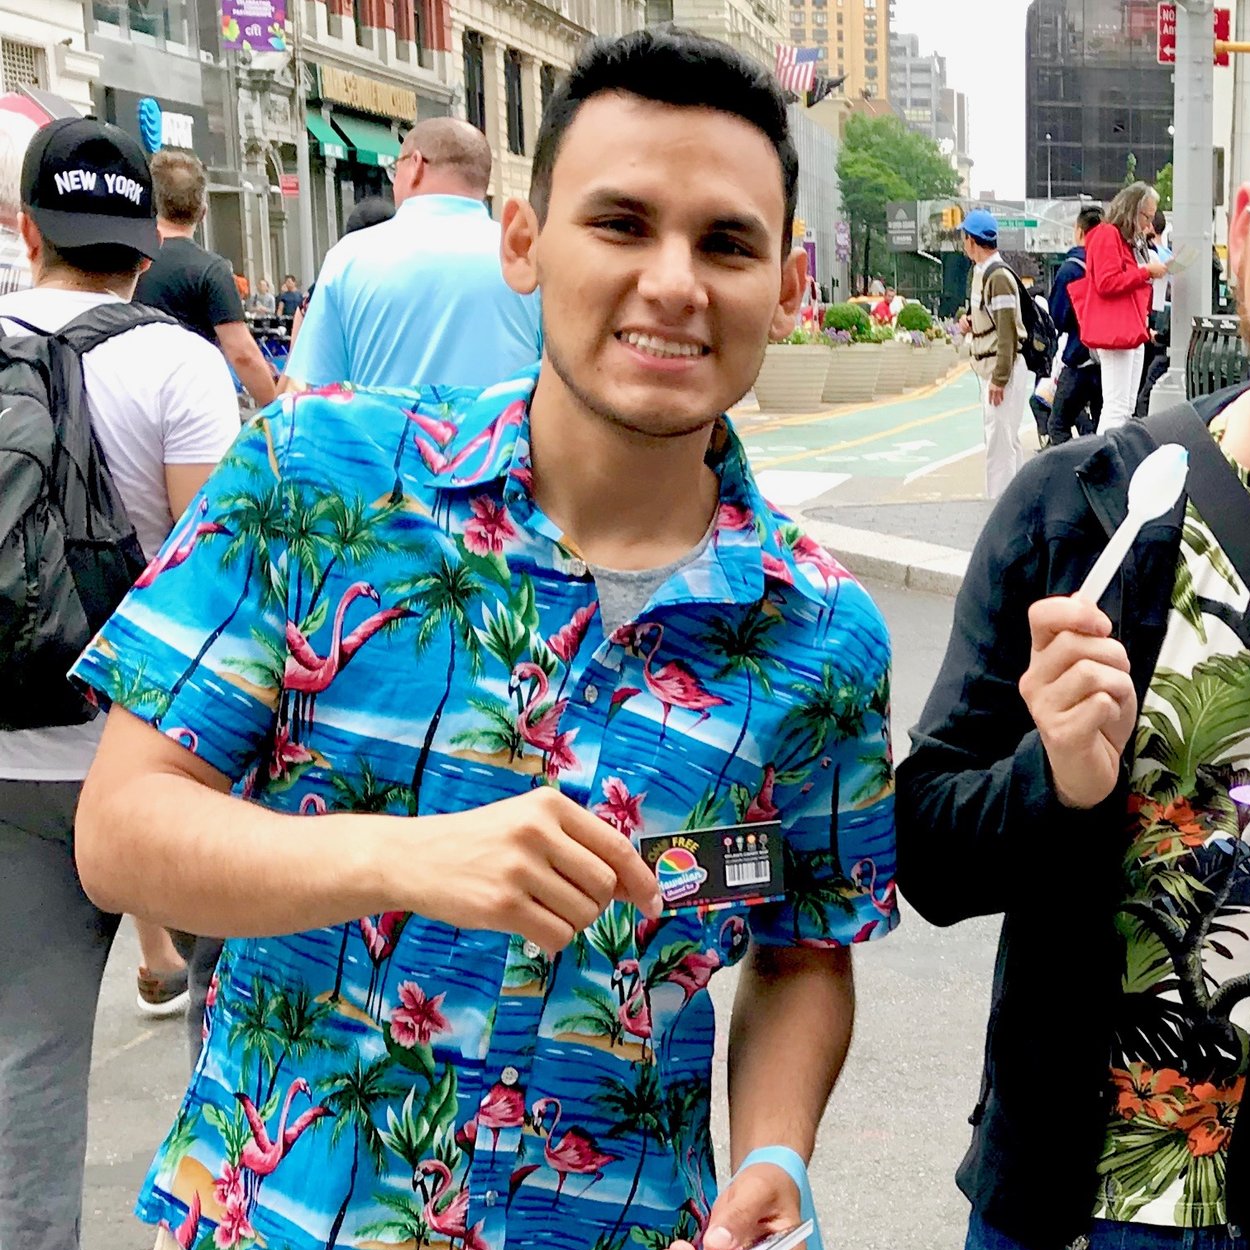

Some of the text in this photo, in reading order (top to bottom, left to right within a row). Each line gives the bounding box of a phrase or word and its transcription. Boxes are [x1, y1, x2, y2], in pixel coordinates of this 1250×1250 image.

[1162, 9, 1175, 21] NO
[54, 169, 144, 205] NEW YORK
[672, 836, 700, 854] FREE
